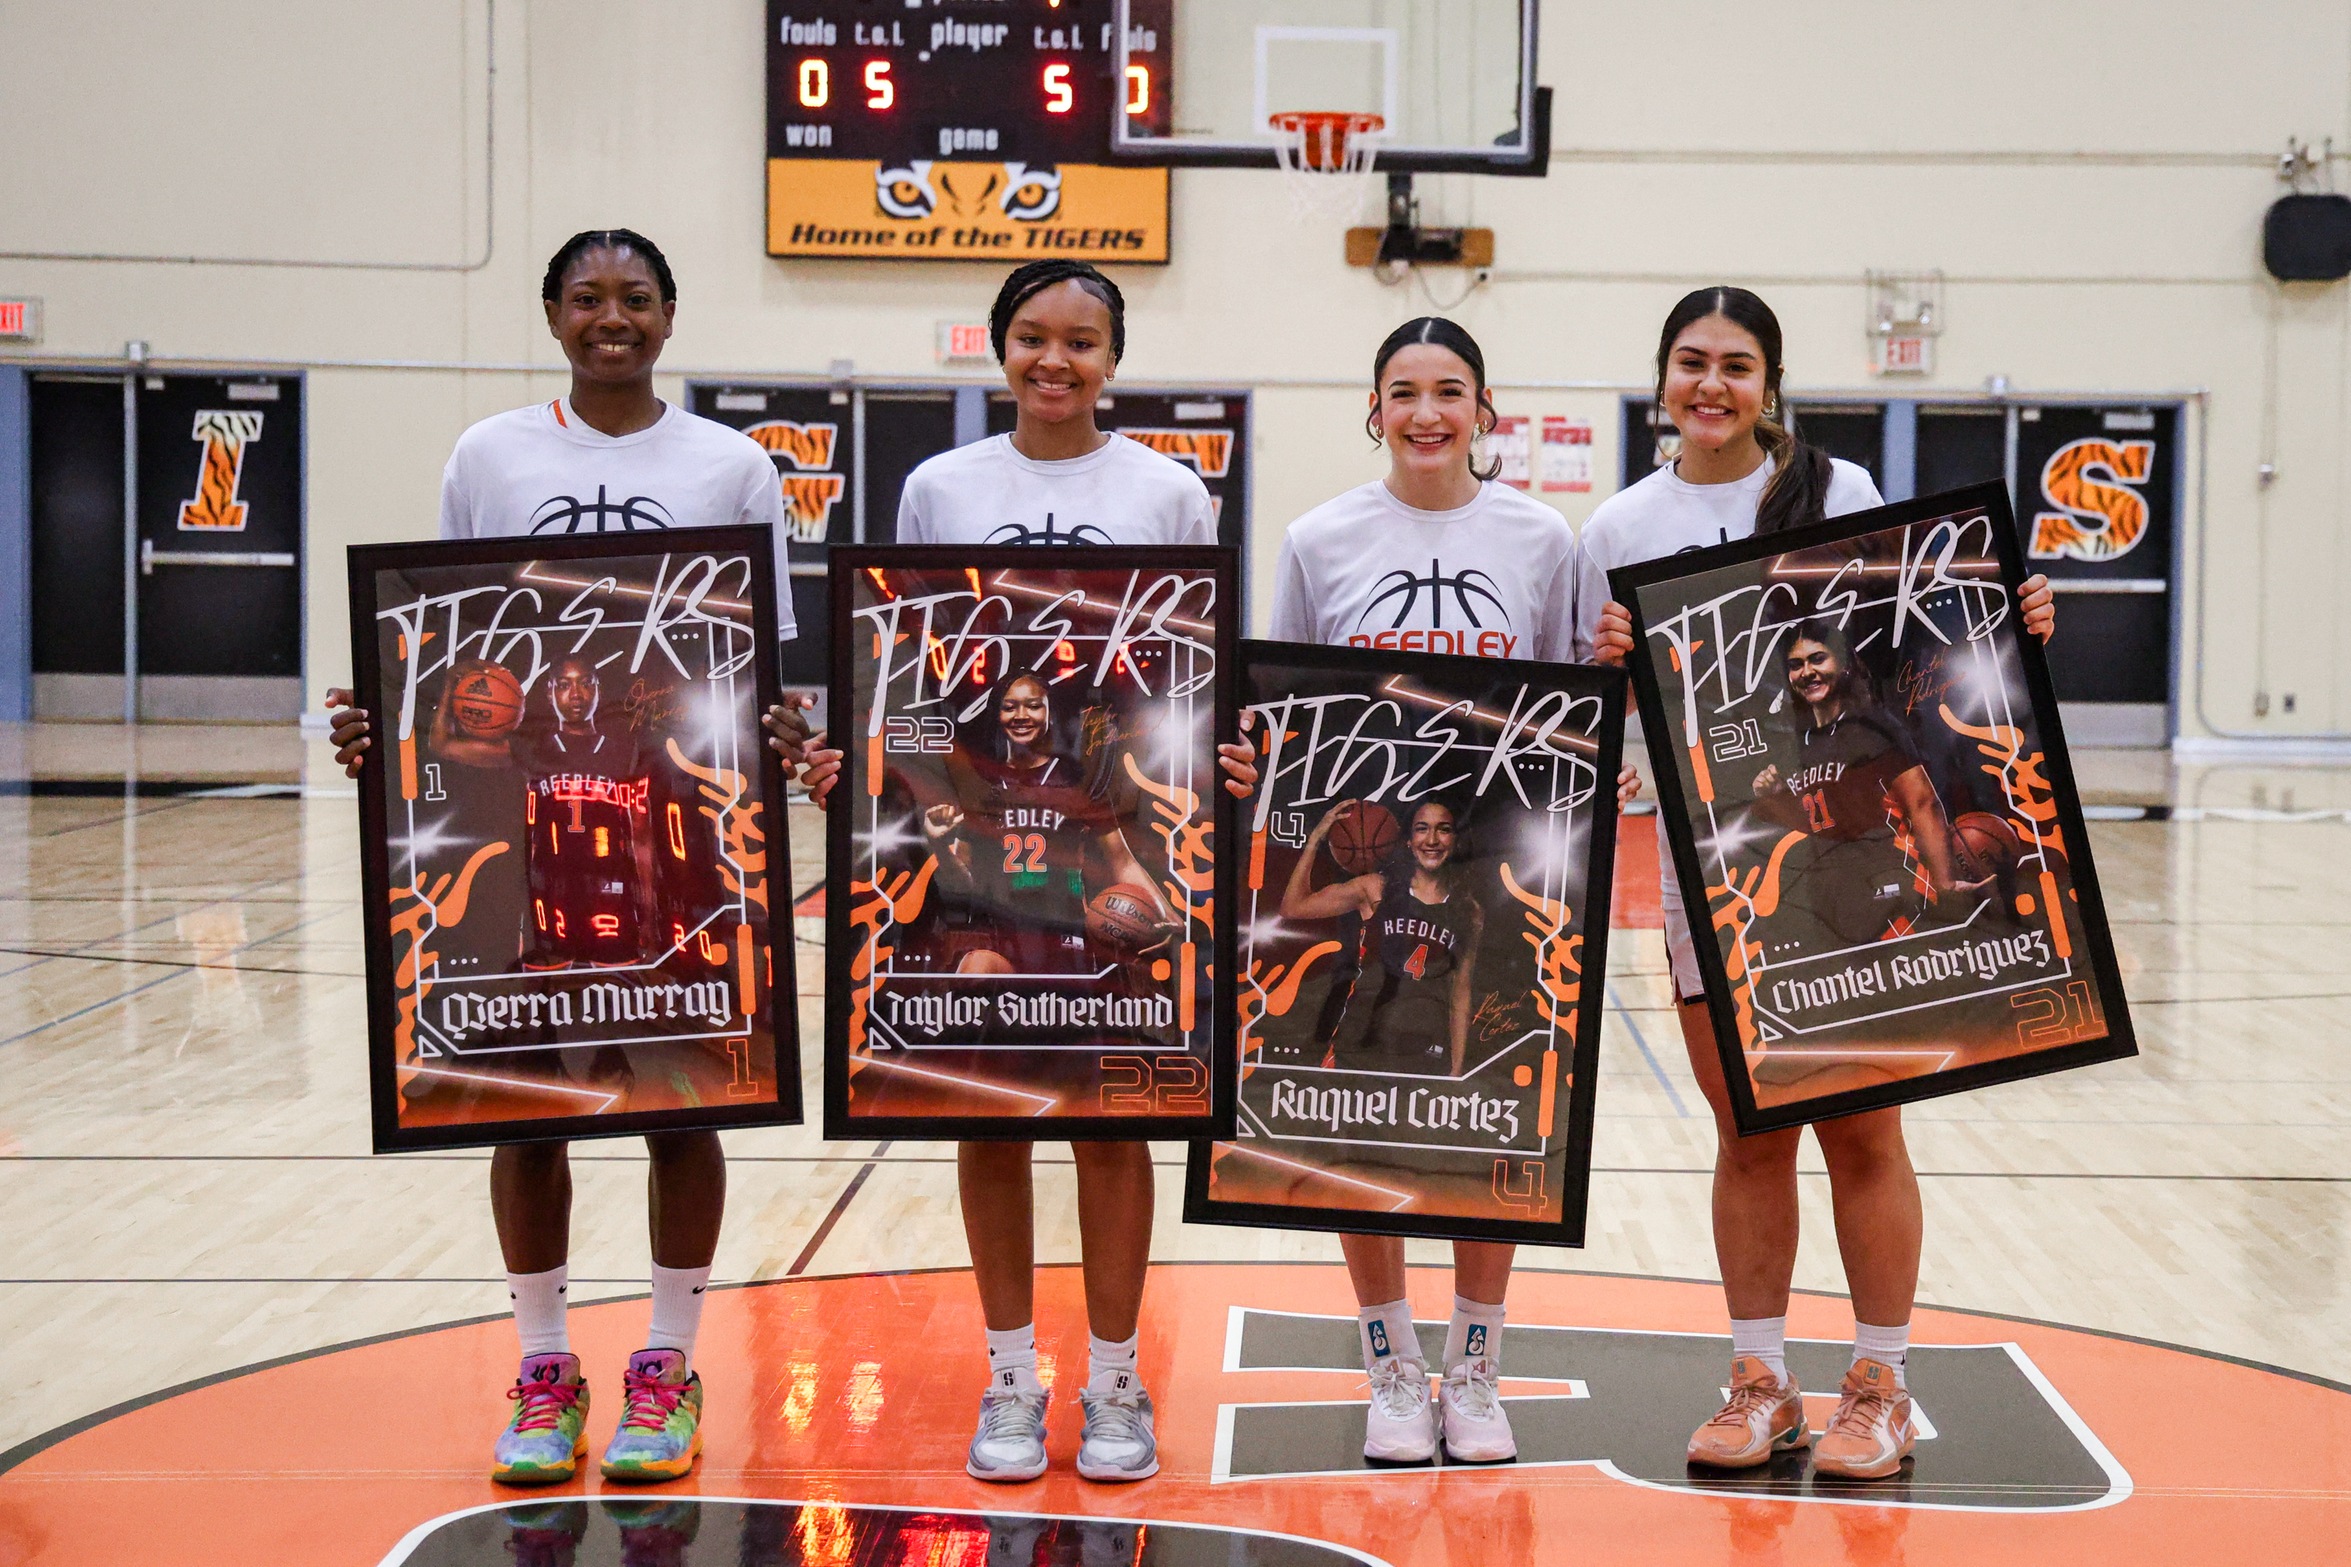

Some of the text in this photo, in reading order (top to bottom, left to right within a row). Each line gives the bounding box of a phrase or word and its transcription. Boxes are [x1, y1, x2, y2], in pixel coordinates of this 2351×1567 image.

[781, 16, 837, 45] fouls
[931, 17, 1009, 51] player
[799, 59, 828, 107] 0
[865, 60, 894, 109] 5
[1043, 64, 1073, 112] 5
[786, 125, 999, 155] won game
[789, 223, 1146, 250] Home of the TIGERS
[0, 302, 25, 333] XIT
[951, 325, 987, 355] EXIT
[177, 410, 264, 531] I
[2028, 436, 2156, 562] S
[886, 716, 955, 754] 22
[1708, 717, 1769, 763] 21
[425, 763, 448, 801] 1
[567, 799, 586, 833] 1
[1005, 808, 1065, 831] EDLEY
[1003, 832, 1048, 873] 22
[1403, 943, 1429, 981] 4
[1772, 929, 2051, 1015] Chantel Rodriguez
[582, 980, 733, 1028] Murray
[885, 990, 1173, 1037] Taylor Sutherland
[2010, 980, 2107, 1050] 21
[726, 1038, 759, 1097] 1
[1099, 1055, 1208, 1113] 22
[1271, 1078, 1520, 1144] Raquel Cortez
